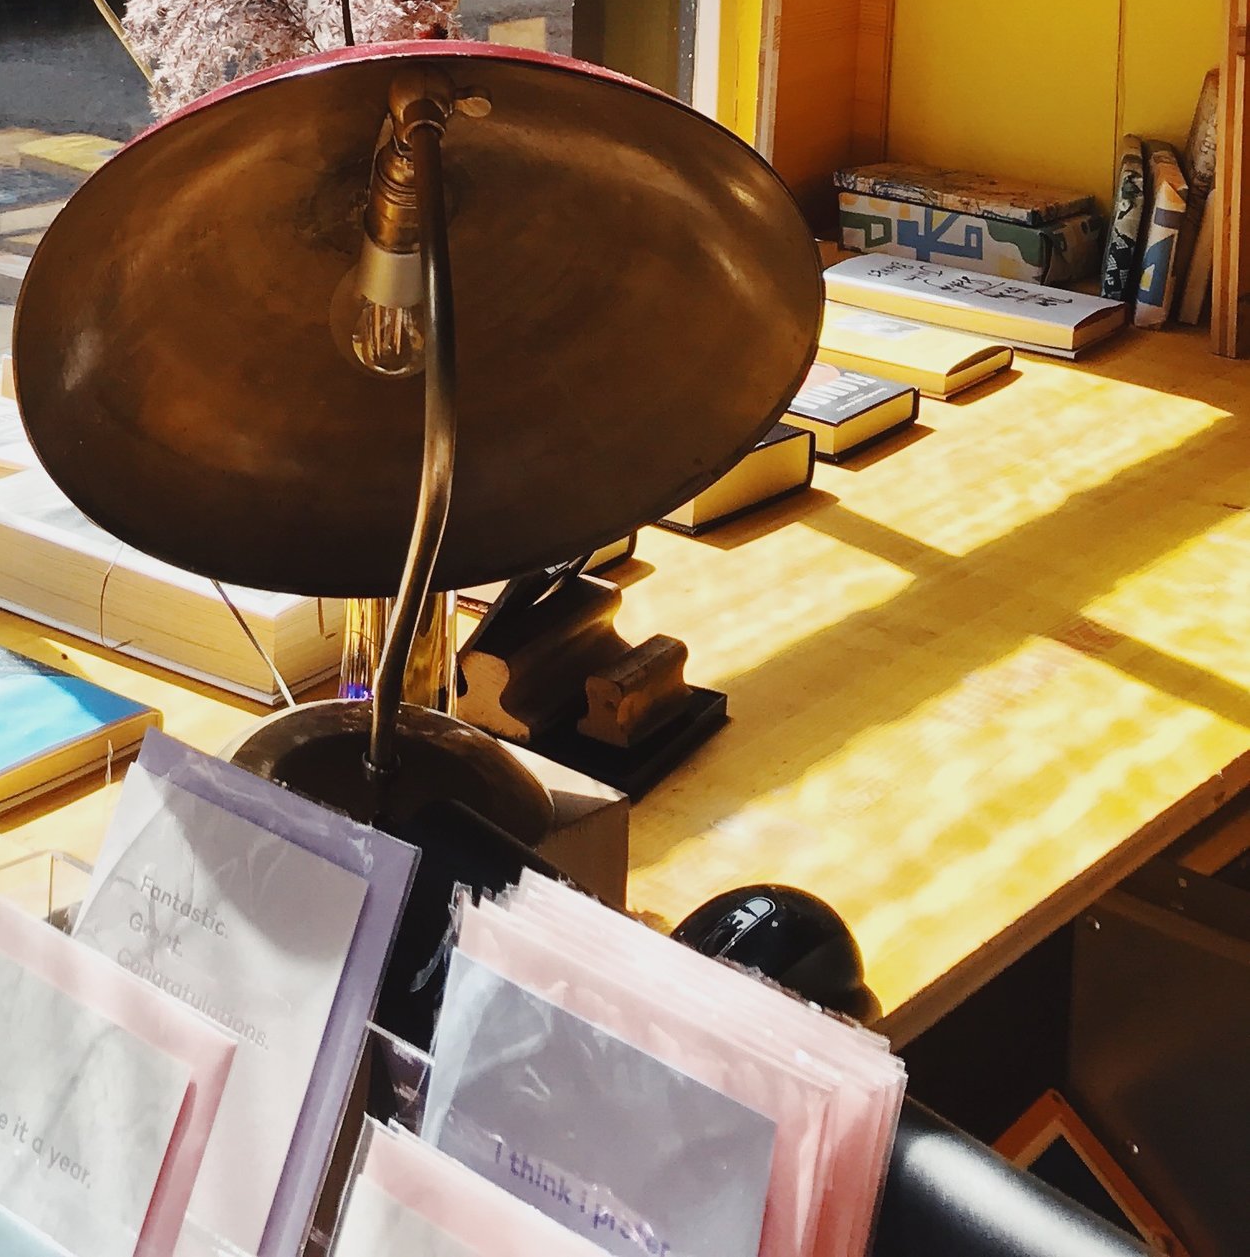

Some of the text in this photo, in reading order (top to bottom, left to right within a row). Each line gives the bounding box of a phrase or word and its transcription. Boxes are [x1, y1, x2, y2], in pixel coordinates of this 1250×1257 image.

[12, 1116, 29, 1143] it
[31, 1137, 44, 1155] a
[47, 1146, 91, 1190] year.
[510, 1151, 572, 1205] think
